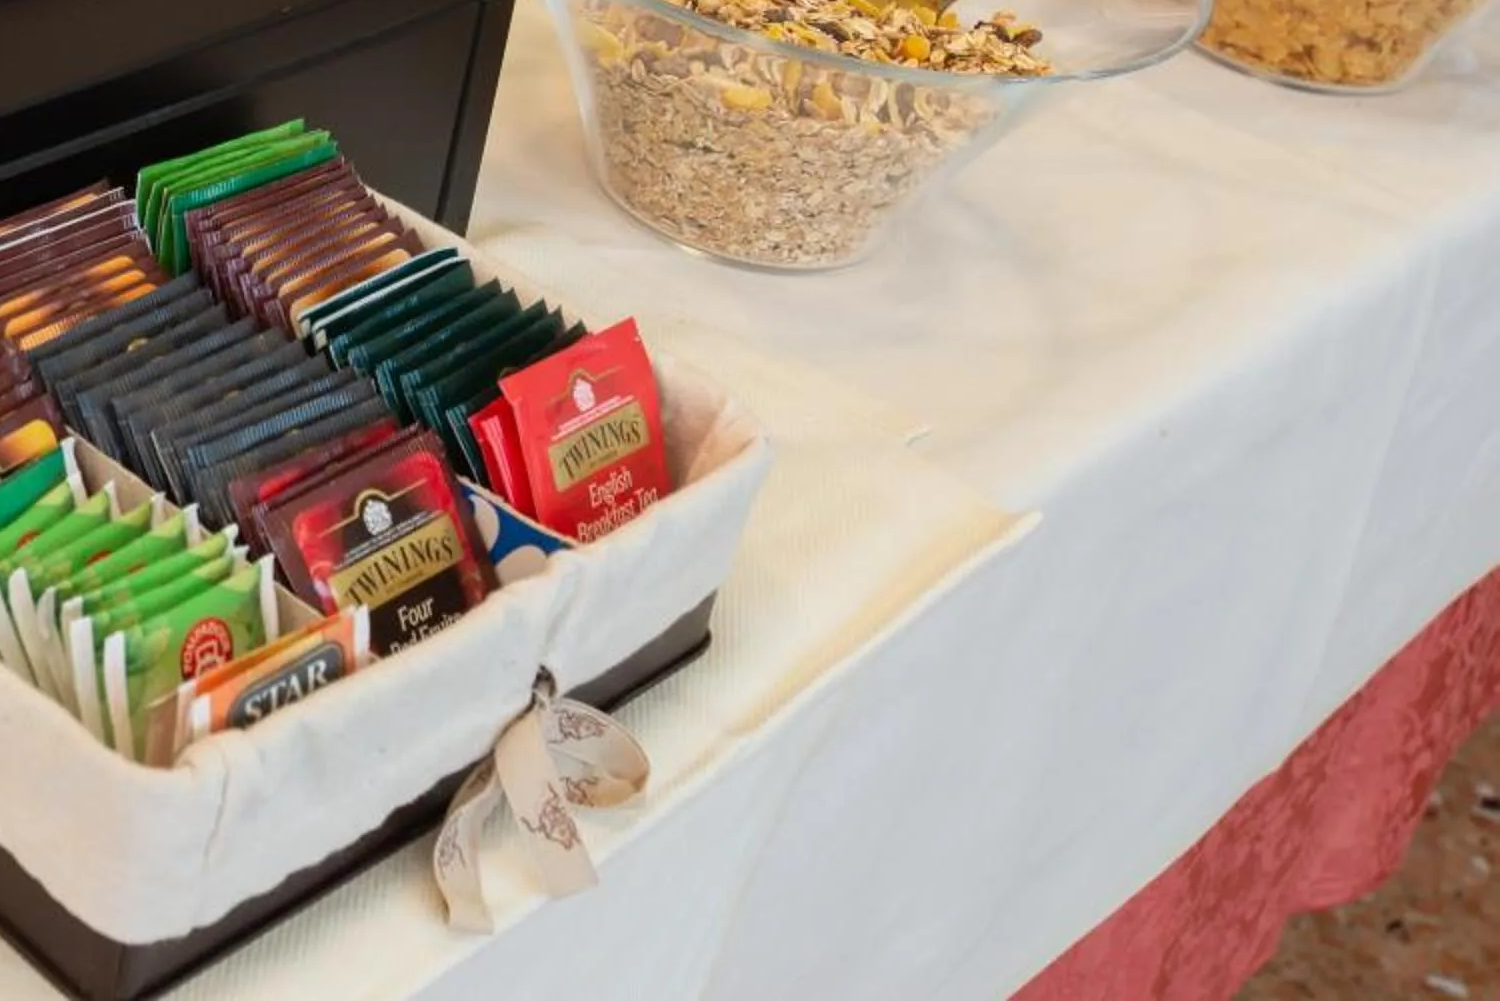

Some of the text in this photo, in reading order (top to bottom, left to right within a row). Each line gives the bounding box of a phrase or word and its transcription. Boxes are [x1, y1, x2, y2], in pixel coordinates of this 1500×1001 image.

[559, 421, 643, 480] TWININGS
[588, 466, 633, 509] English
[344, 536, 454, 607] TWININGS
[396, 597, 435, 632] Four
[244, 658, 328, 721] STAR
